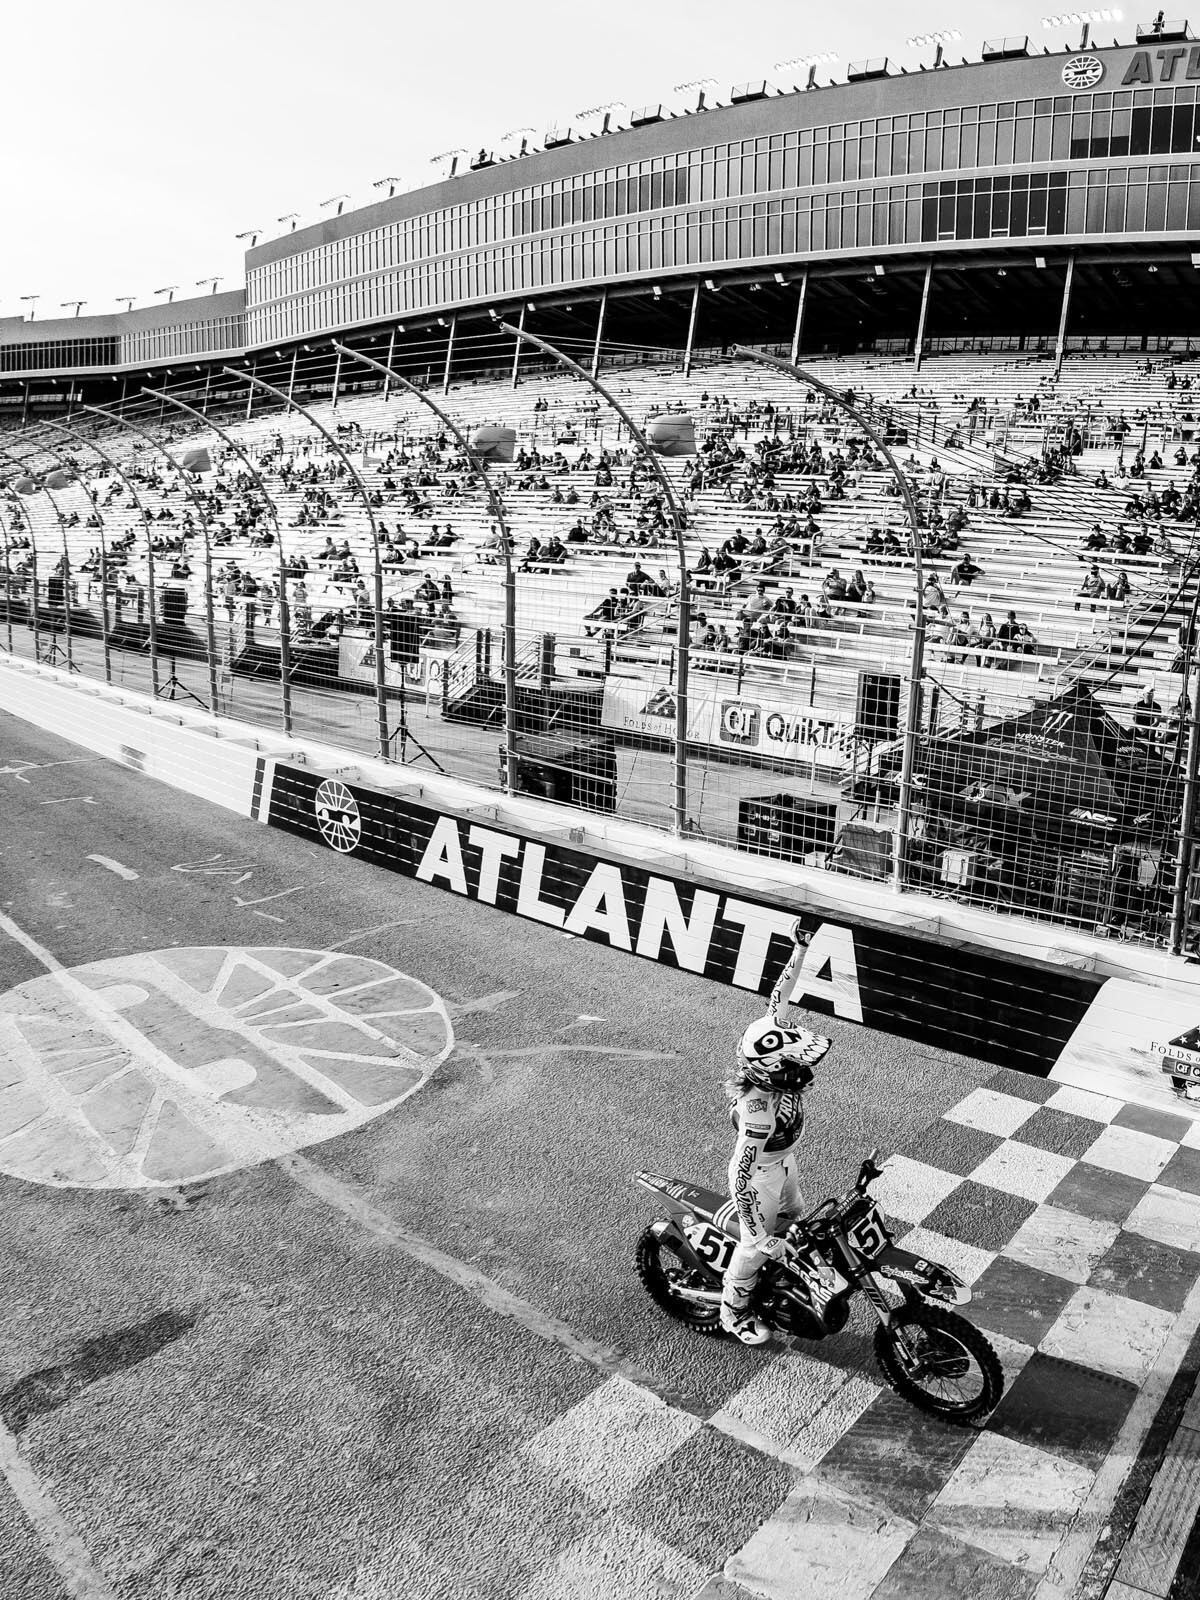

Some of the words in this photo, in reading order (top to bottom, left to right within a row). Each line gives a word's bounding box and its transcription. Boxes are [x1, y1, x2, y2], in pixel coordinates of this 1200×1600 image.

[623, 716, 652, 731] FOLDS
[653, 723, 663, 734] of
[664, 723, 701, 740] HOOR
[723, 705, 757, 740] QT
[416, 815, 864, 1024] ATLANTA
[1150, 1041, 1192, 1061] FOLDS
[1176, 1063, 1190, 1074] QT
[696, 1227, 737, 1269] 51
[853, 1208, 888, 1258] 51
[777, 1254, 834, 1302] ASGAS
